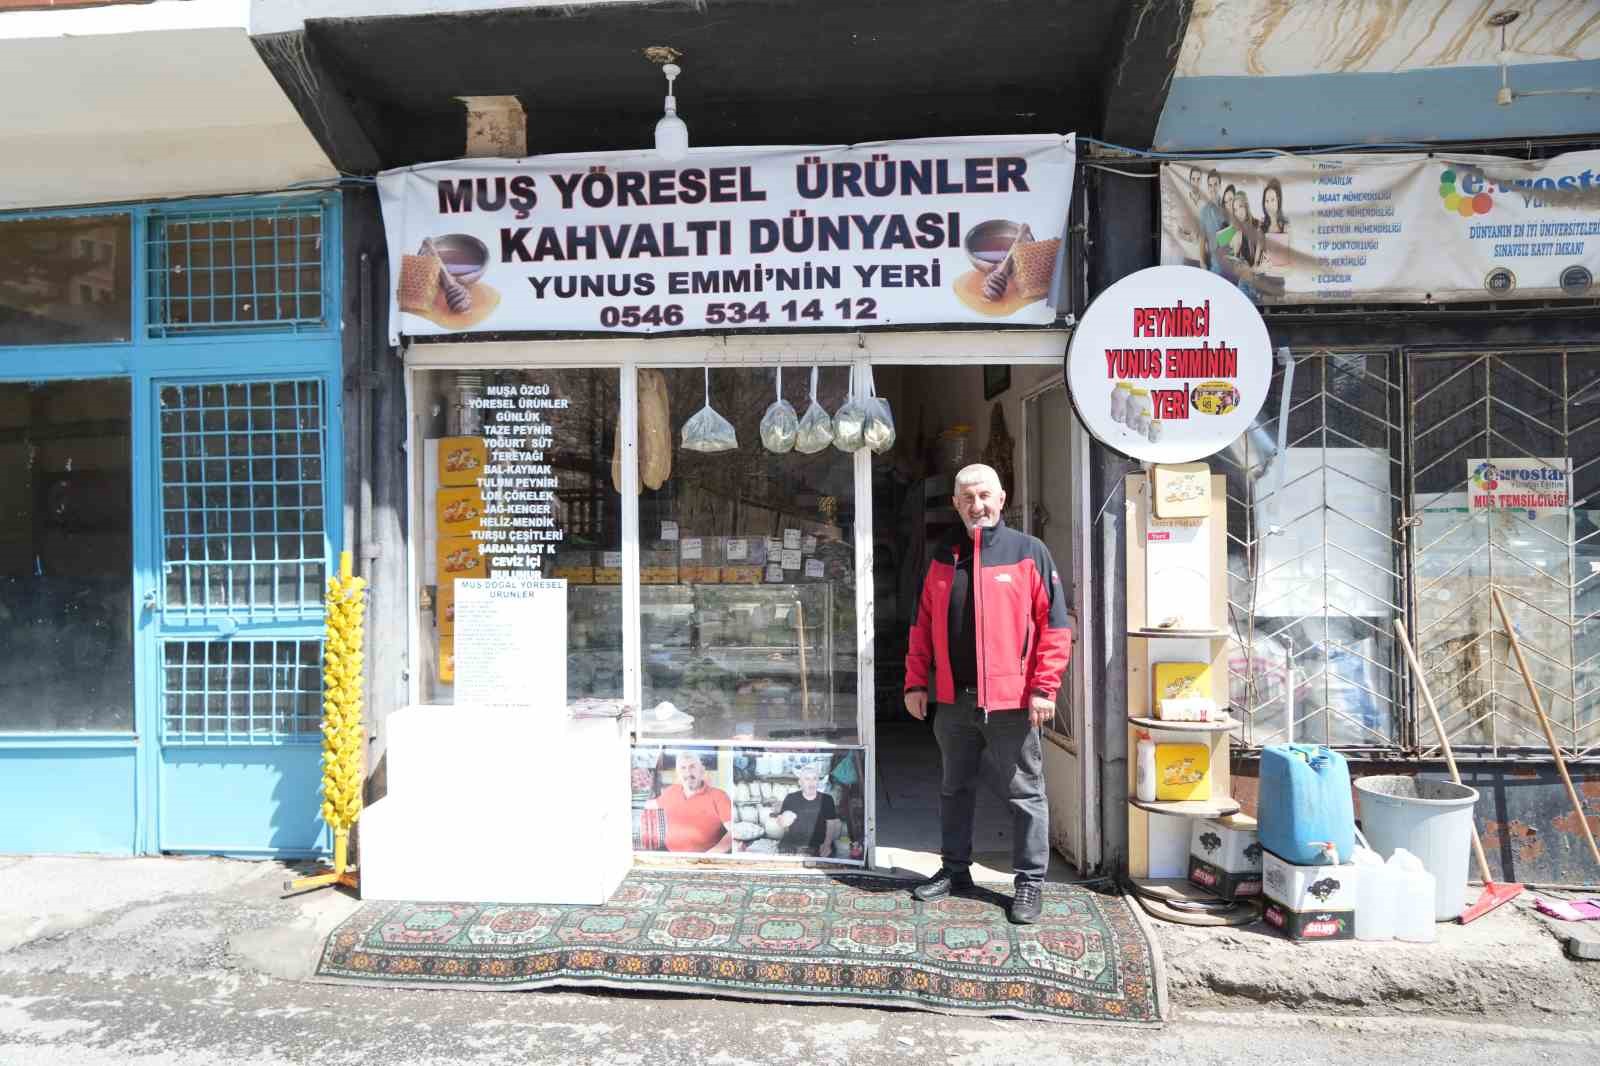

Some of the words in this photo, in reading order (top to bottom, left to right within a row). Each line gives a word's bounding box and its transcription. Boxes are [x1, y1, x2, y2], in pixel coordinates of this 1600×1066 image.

[438, 175, 538, 219] MUŞ
[550, 165, 767, 209] YÖRESEL
[796, 154, 1030, 200] ÜRÜNLER
[500, 220, 732, 263] KAHVALTI
[750, 209, 960, 254] DÜNYASI
[528, 272, 655, 299] YUNUS
[853, 258, 941, 288] YERİ
[600, 304, 684, 328] 0546
[705, 301, 769, 325] 534
[781, 299, 823, 322] 14
[835, 297, 877, 320] 12
[1133, 300, 1210, 337] PEYNİRCİ
[1104, 348, 1163, 379] YUNUS
[1165, 341, 1238, 379] EMMİNİN
[487, 386, 518, 398] MUŞA
[520, 384, 549, 396] ÖZGÜ
[469, 398, 515, 409] YÖRESEL
[519, 398, 568, 409] ÜRÜNLER
[1150, 382, 1190, 419] YERİ
[496, 411, 541, 422] GÜNLÜK
[484, 426, 510, 435] TAZE
[513, 425, 552, 435] PEYNİR
[482, 436, 525, 448] YOĞURT
[531, 437, 553, 448] SÜT
[492, 451, 544, 461] TEREYAĞI
[484, 465, 551, 475] BAL-KAYMAK
[476, 478, 514, 488] TULUM
[516, 476, 558, 488] PEYNİRİ
[504, 490, 553, 502] ÇÖKELEK
[471, 530, 506, 542] TURŞU
[508, 529, 563, 542] ÇEŞİTLERİ
[492, 555, 523, 567] CEVİZ
[526, 555, 541, 569] İÇİ
